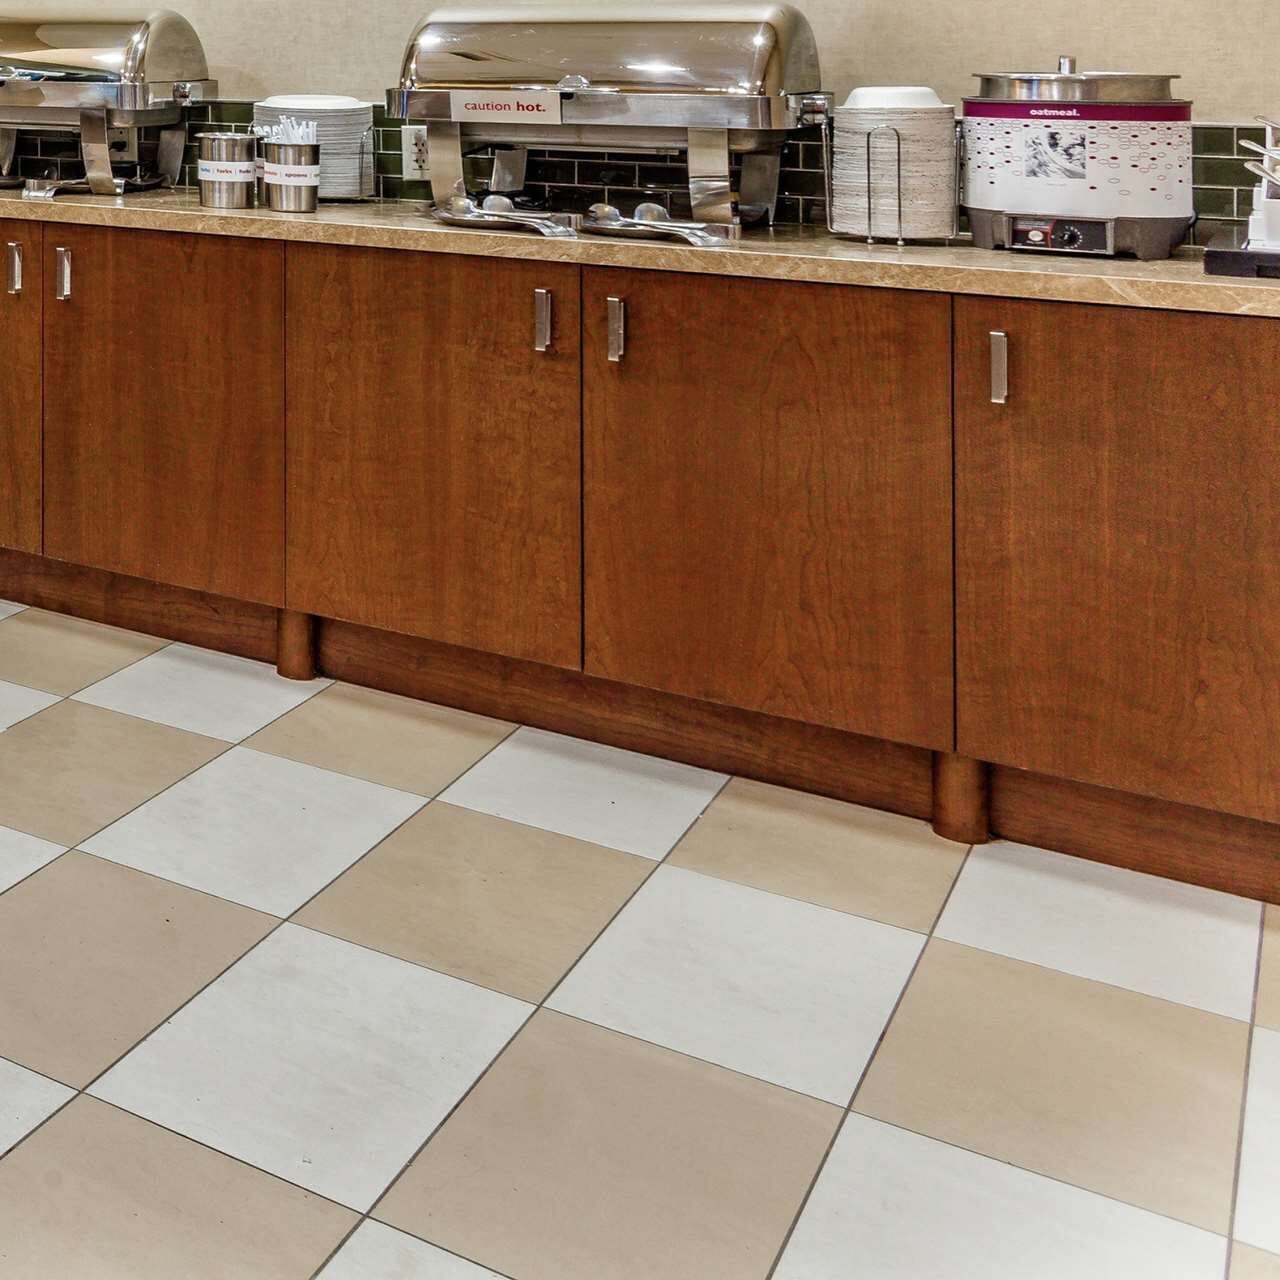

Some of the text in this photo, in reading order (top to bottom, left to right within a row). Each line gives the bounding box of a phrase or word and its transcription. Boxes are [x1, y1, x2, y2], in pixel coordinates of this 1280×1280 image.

[464, 101, 547, 112] caution hot.
[1029, 108, 1081, 117] oatmeal.
